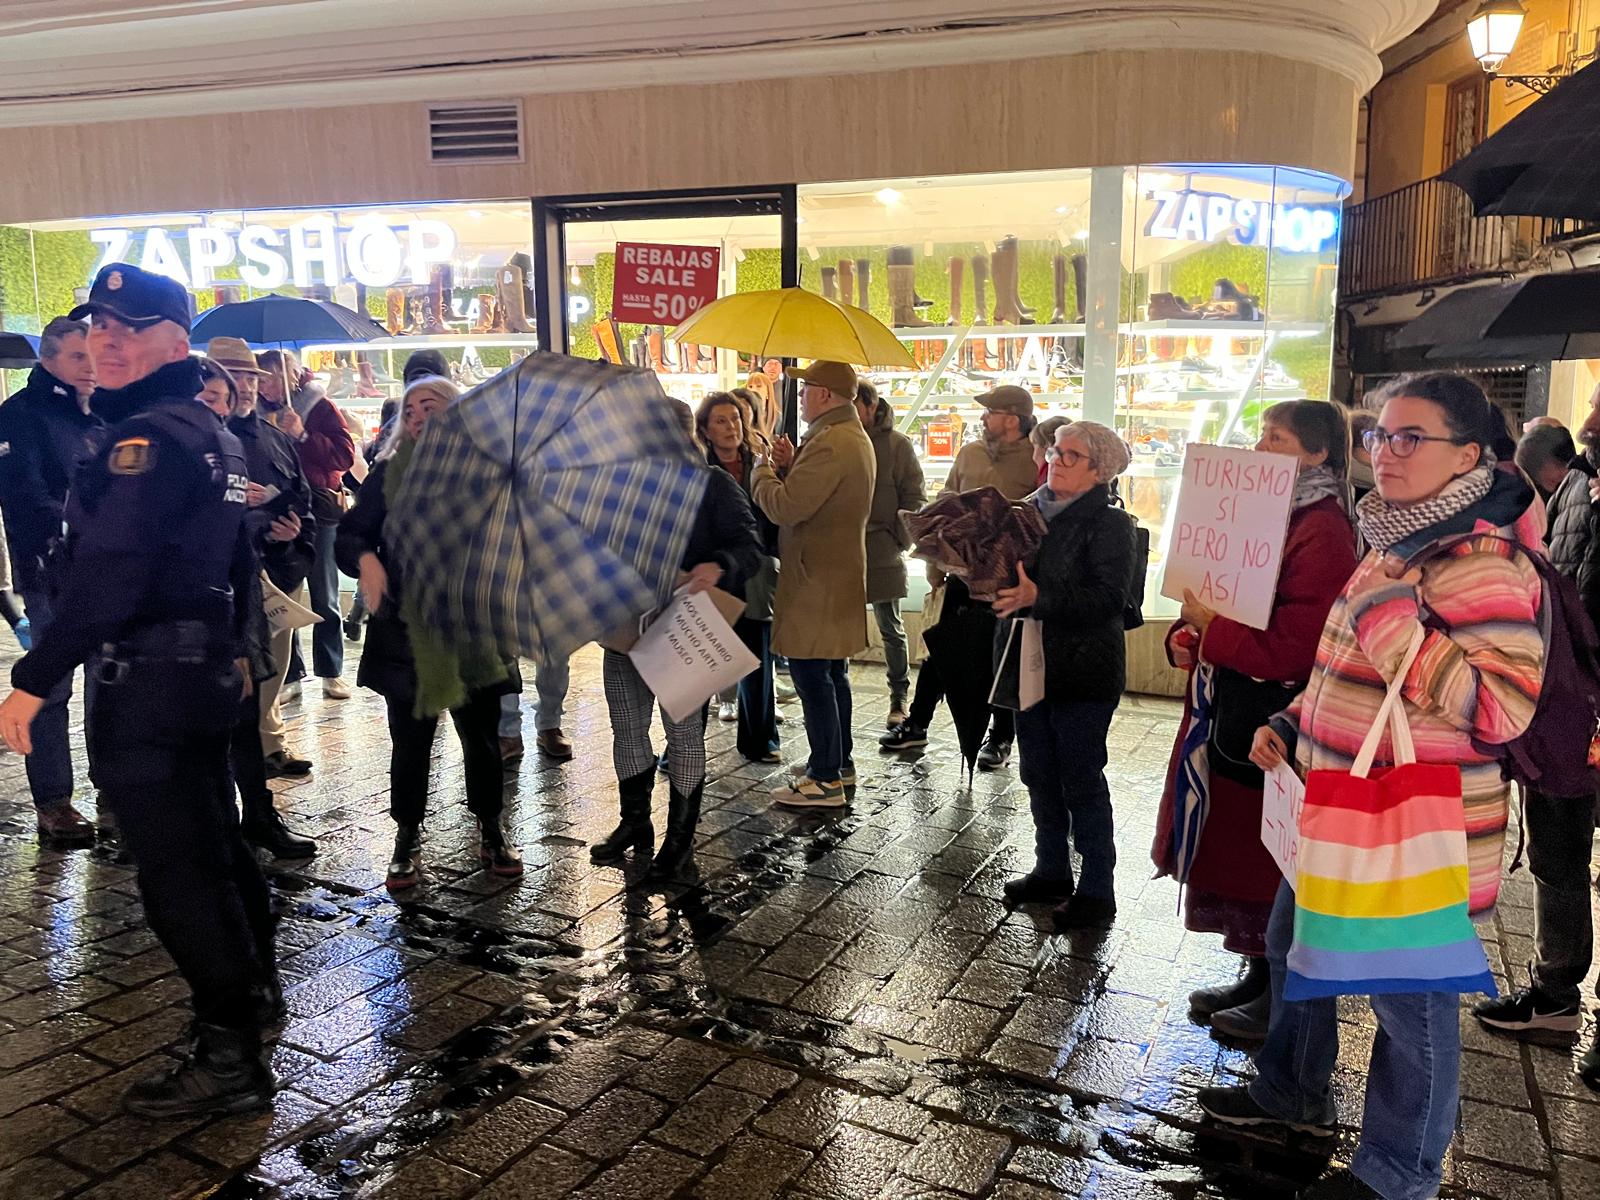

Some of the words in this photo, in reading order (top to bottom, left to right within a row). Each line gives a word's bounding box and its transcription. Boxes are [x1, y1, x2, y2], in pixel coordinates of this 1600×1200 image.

[1151, 190, 1335, 252] ZAPSHOP
[90, 215, 456, 290] ZAPSHOP
[623, 247, 713, 269] REBAJAS
[636, 267, 696, 287] SALE
[622, 294, 650, 303] HASTA
[1193, 457, 1290, 496] TURISMO
[1216, 493, 1238, 523] SÍ
[1177, 523, 1228, 561] PERO
[1242, 537, 1271, 568] NO
[1199, 570, 1242, 607] ASÍ
[675, 614, 702, 648] MUCHO
[695, 617, 709, 632] UN
[705, 631, 733, 662] BARRIO
[668, 633, 694, 665] MUSEO
